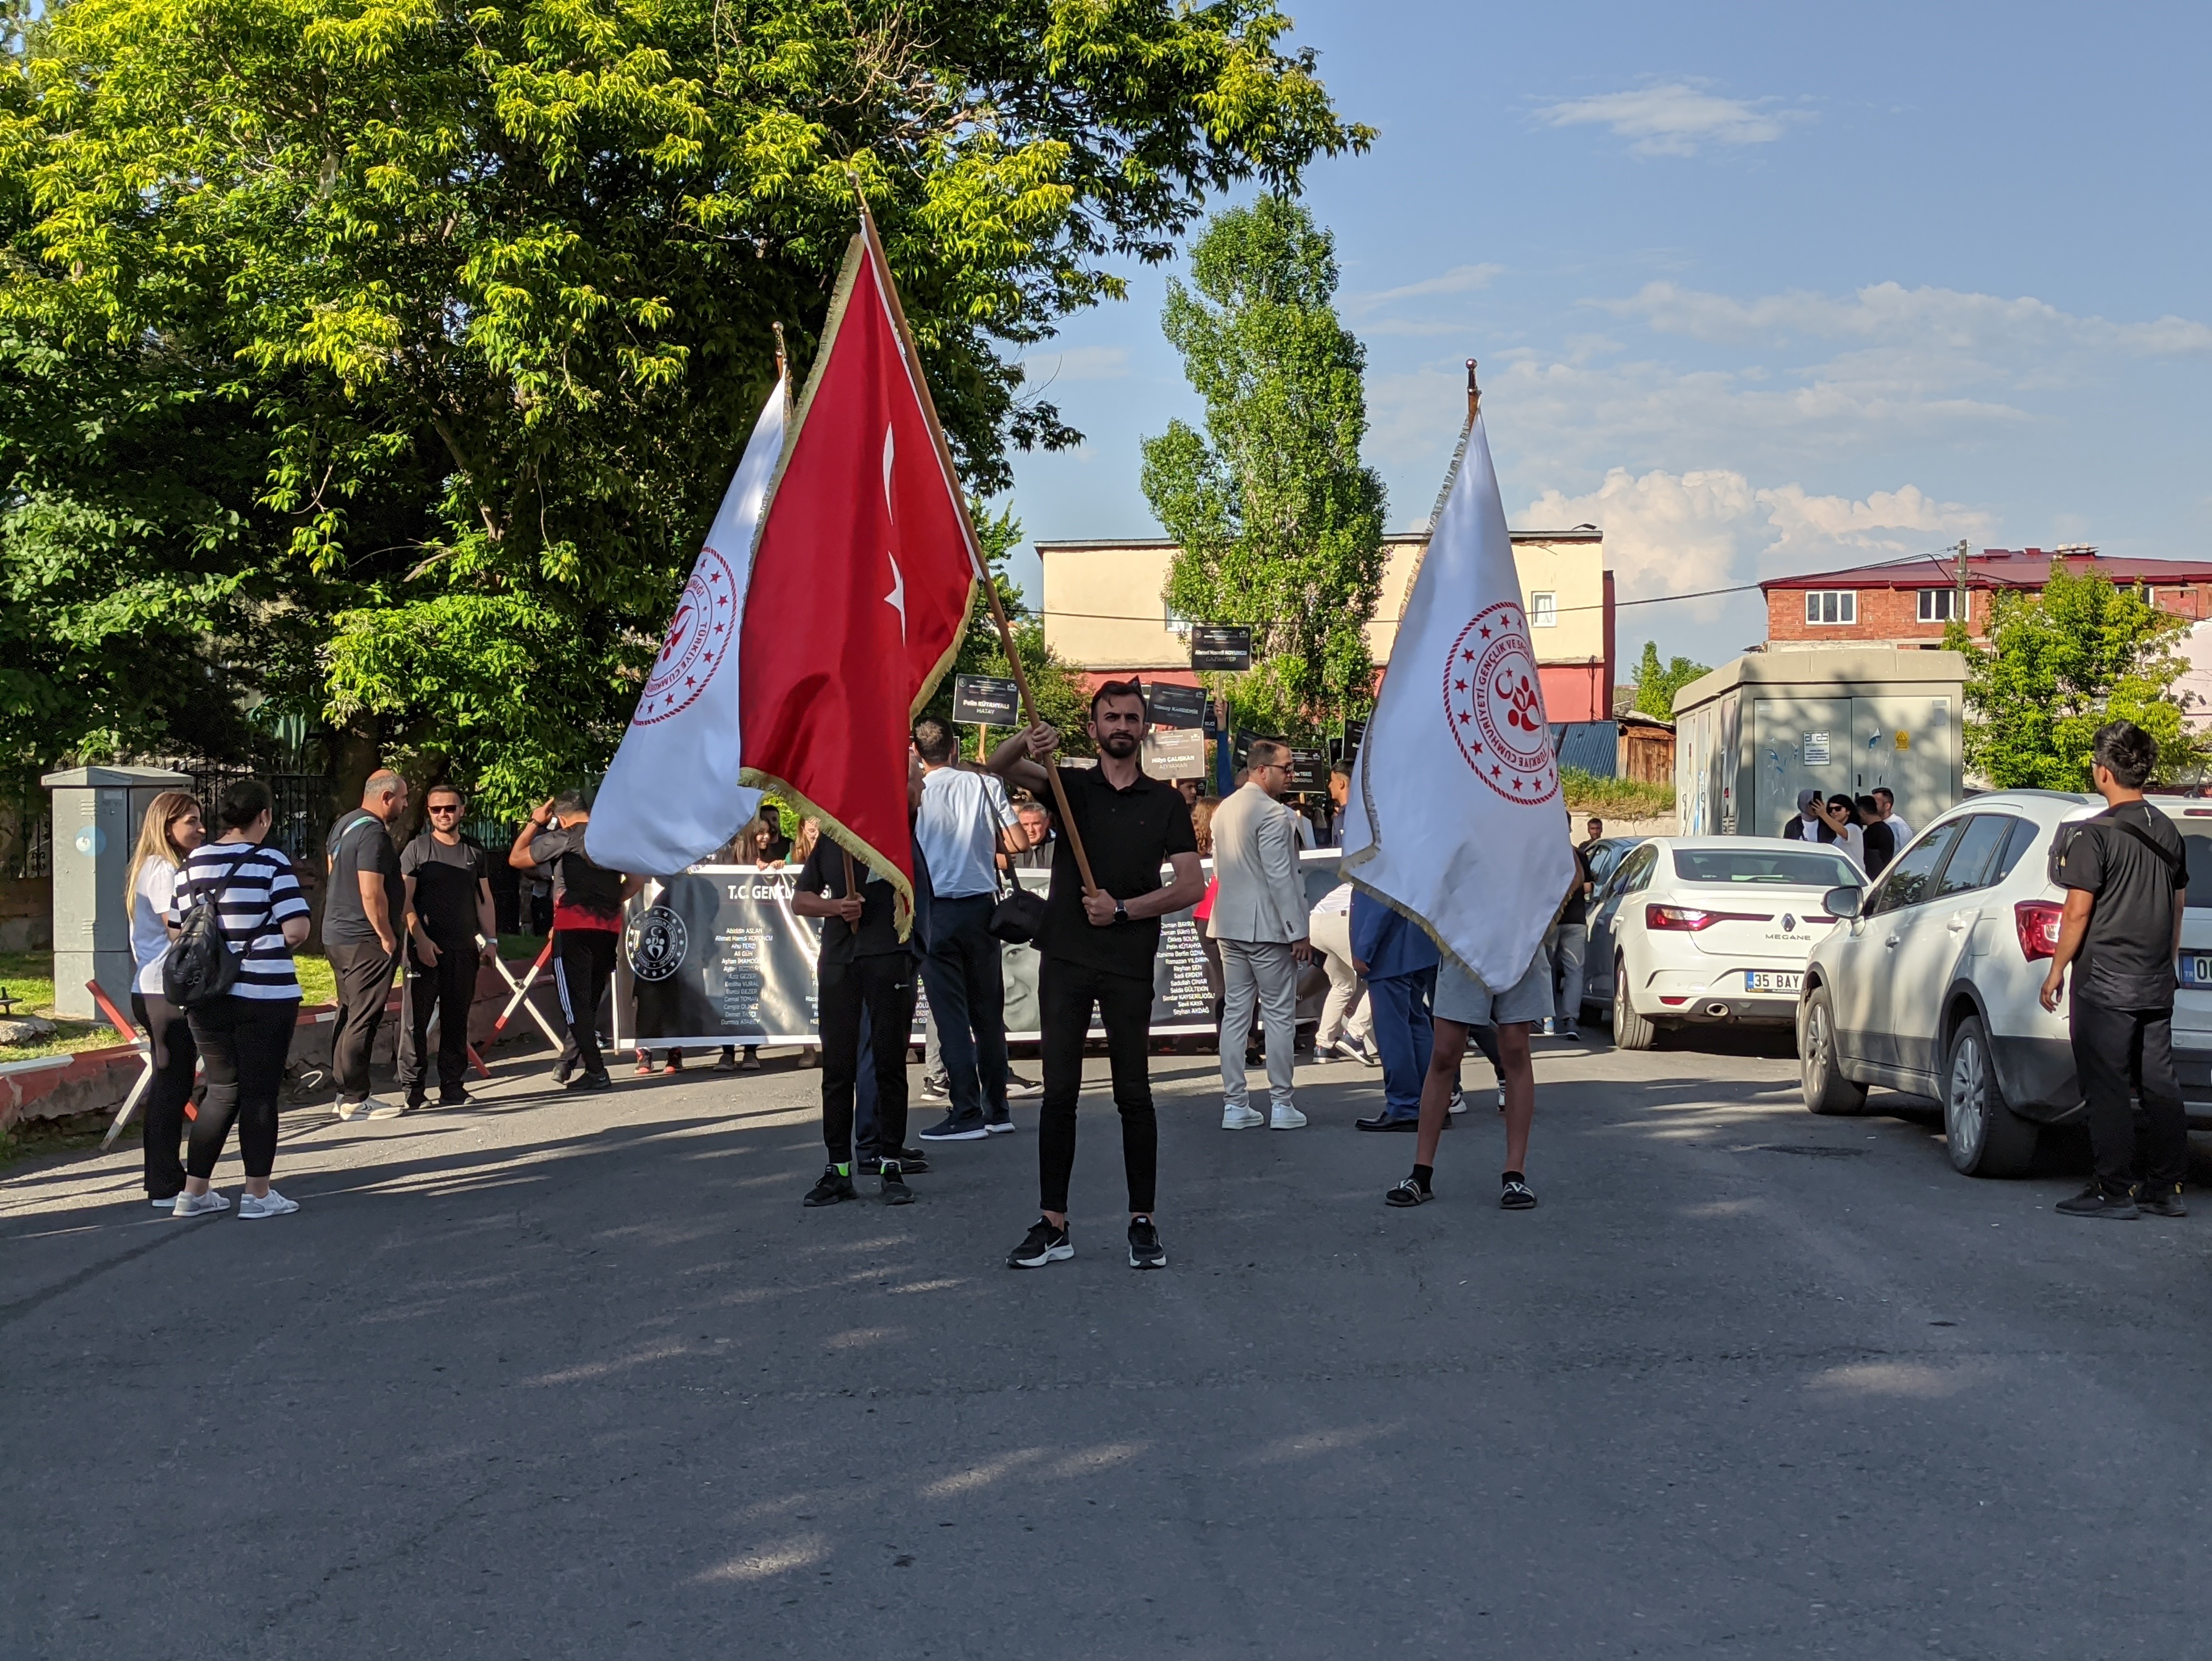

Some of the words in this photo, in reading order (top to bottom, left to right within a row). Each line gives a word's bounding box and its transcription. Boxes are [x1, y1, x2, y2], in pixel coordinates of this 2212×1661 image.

[1506, 639, 1516, 649] VE
[1479, 642, 1507, 685] GENÇLİK
[1475, 688, 1516, 764] CUMHURİYETİ
[1518, 748, 1547, 769] TÜRKİYE
[728, 885, 750, 900] T.C.
[752, 882, 795, 901] GENÇLİ
[2197, 959, 2212, 980] 0
[1755, 974, 1770, 987] 35
[1777, 974, 1799, 988] BAY
